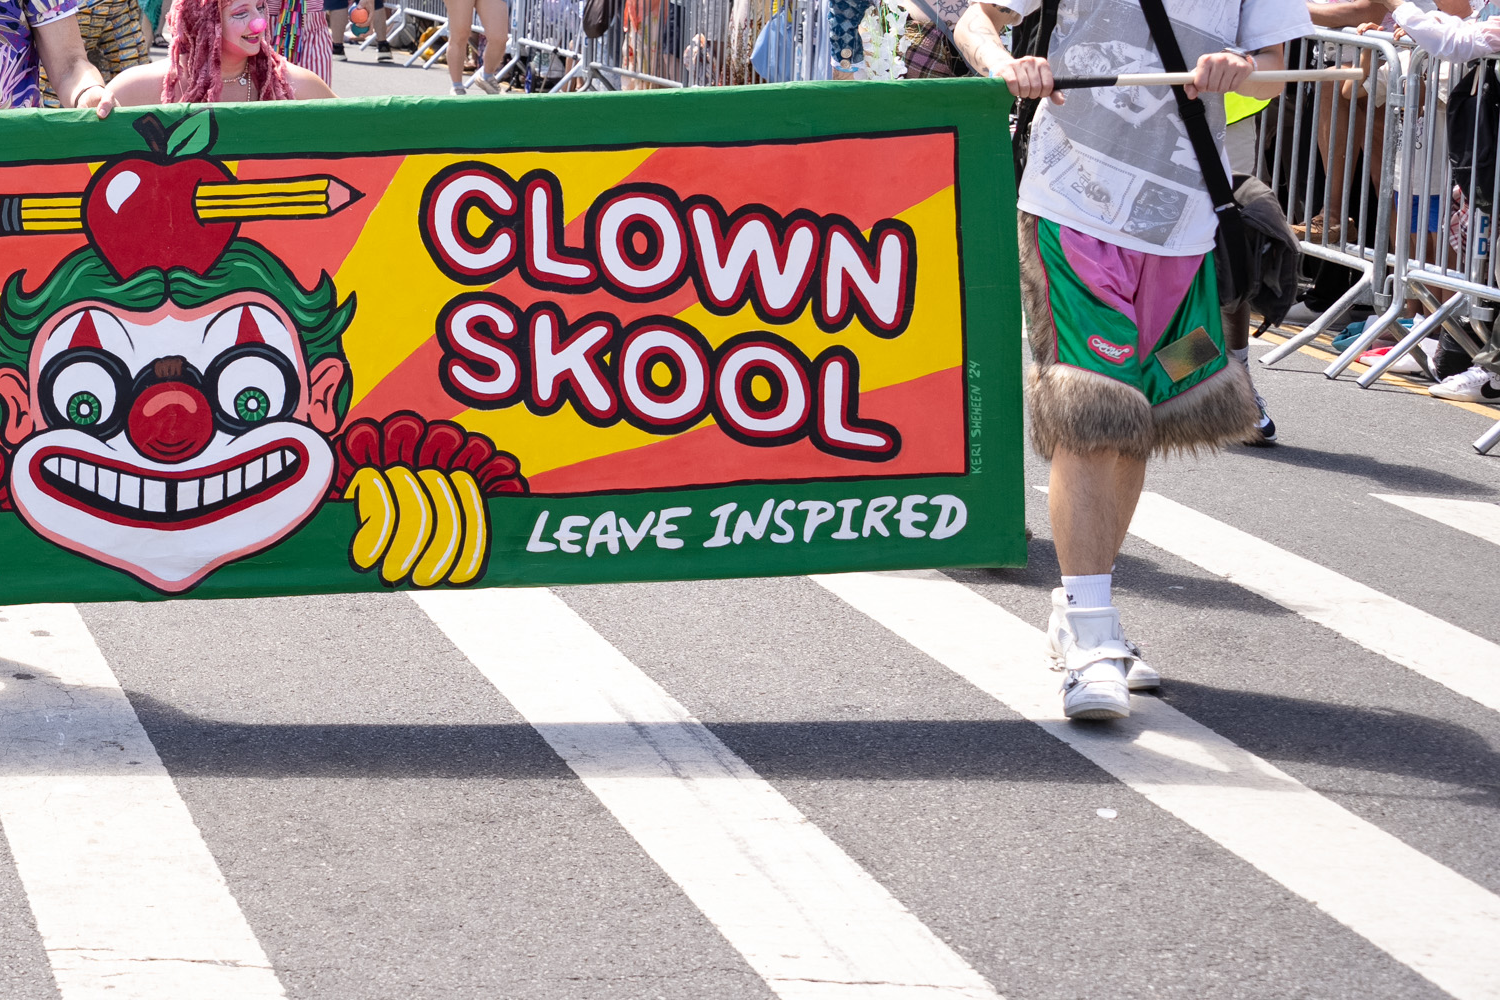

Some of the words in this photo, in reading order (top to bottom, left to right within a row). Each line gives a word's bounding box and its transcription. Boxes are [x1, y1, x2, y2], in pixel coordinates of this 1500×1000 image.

[423, 166, 910, 327] CLOWN
[442, 297, 896, 454] SKOOL
[969, 360, 981, 379] '24
[970, 385, 982, 437] SHEHEEN
[971, 443, 982, 474] KERI
[526, 506, 692, 556] LEAVE
[702, 494, 968, 549] INSPIRED
